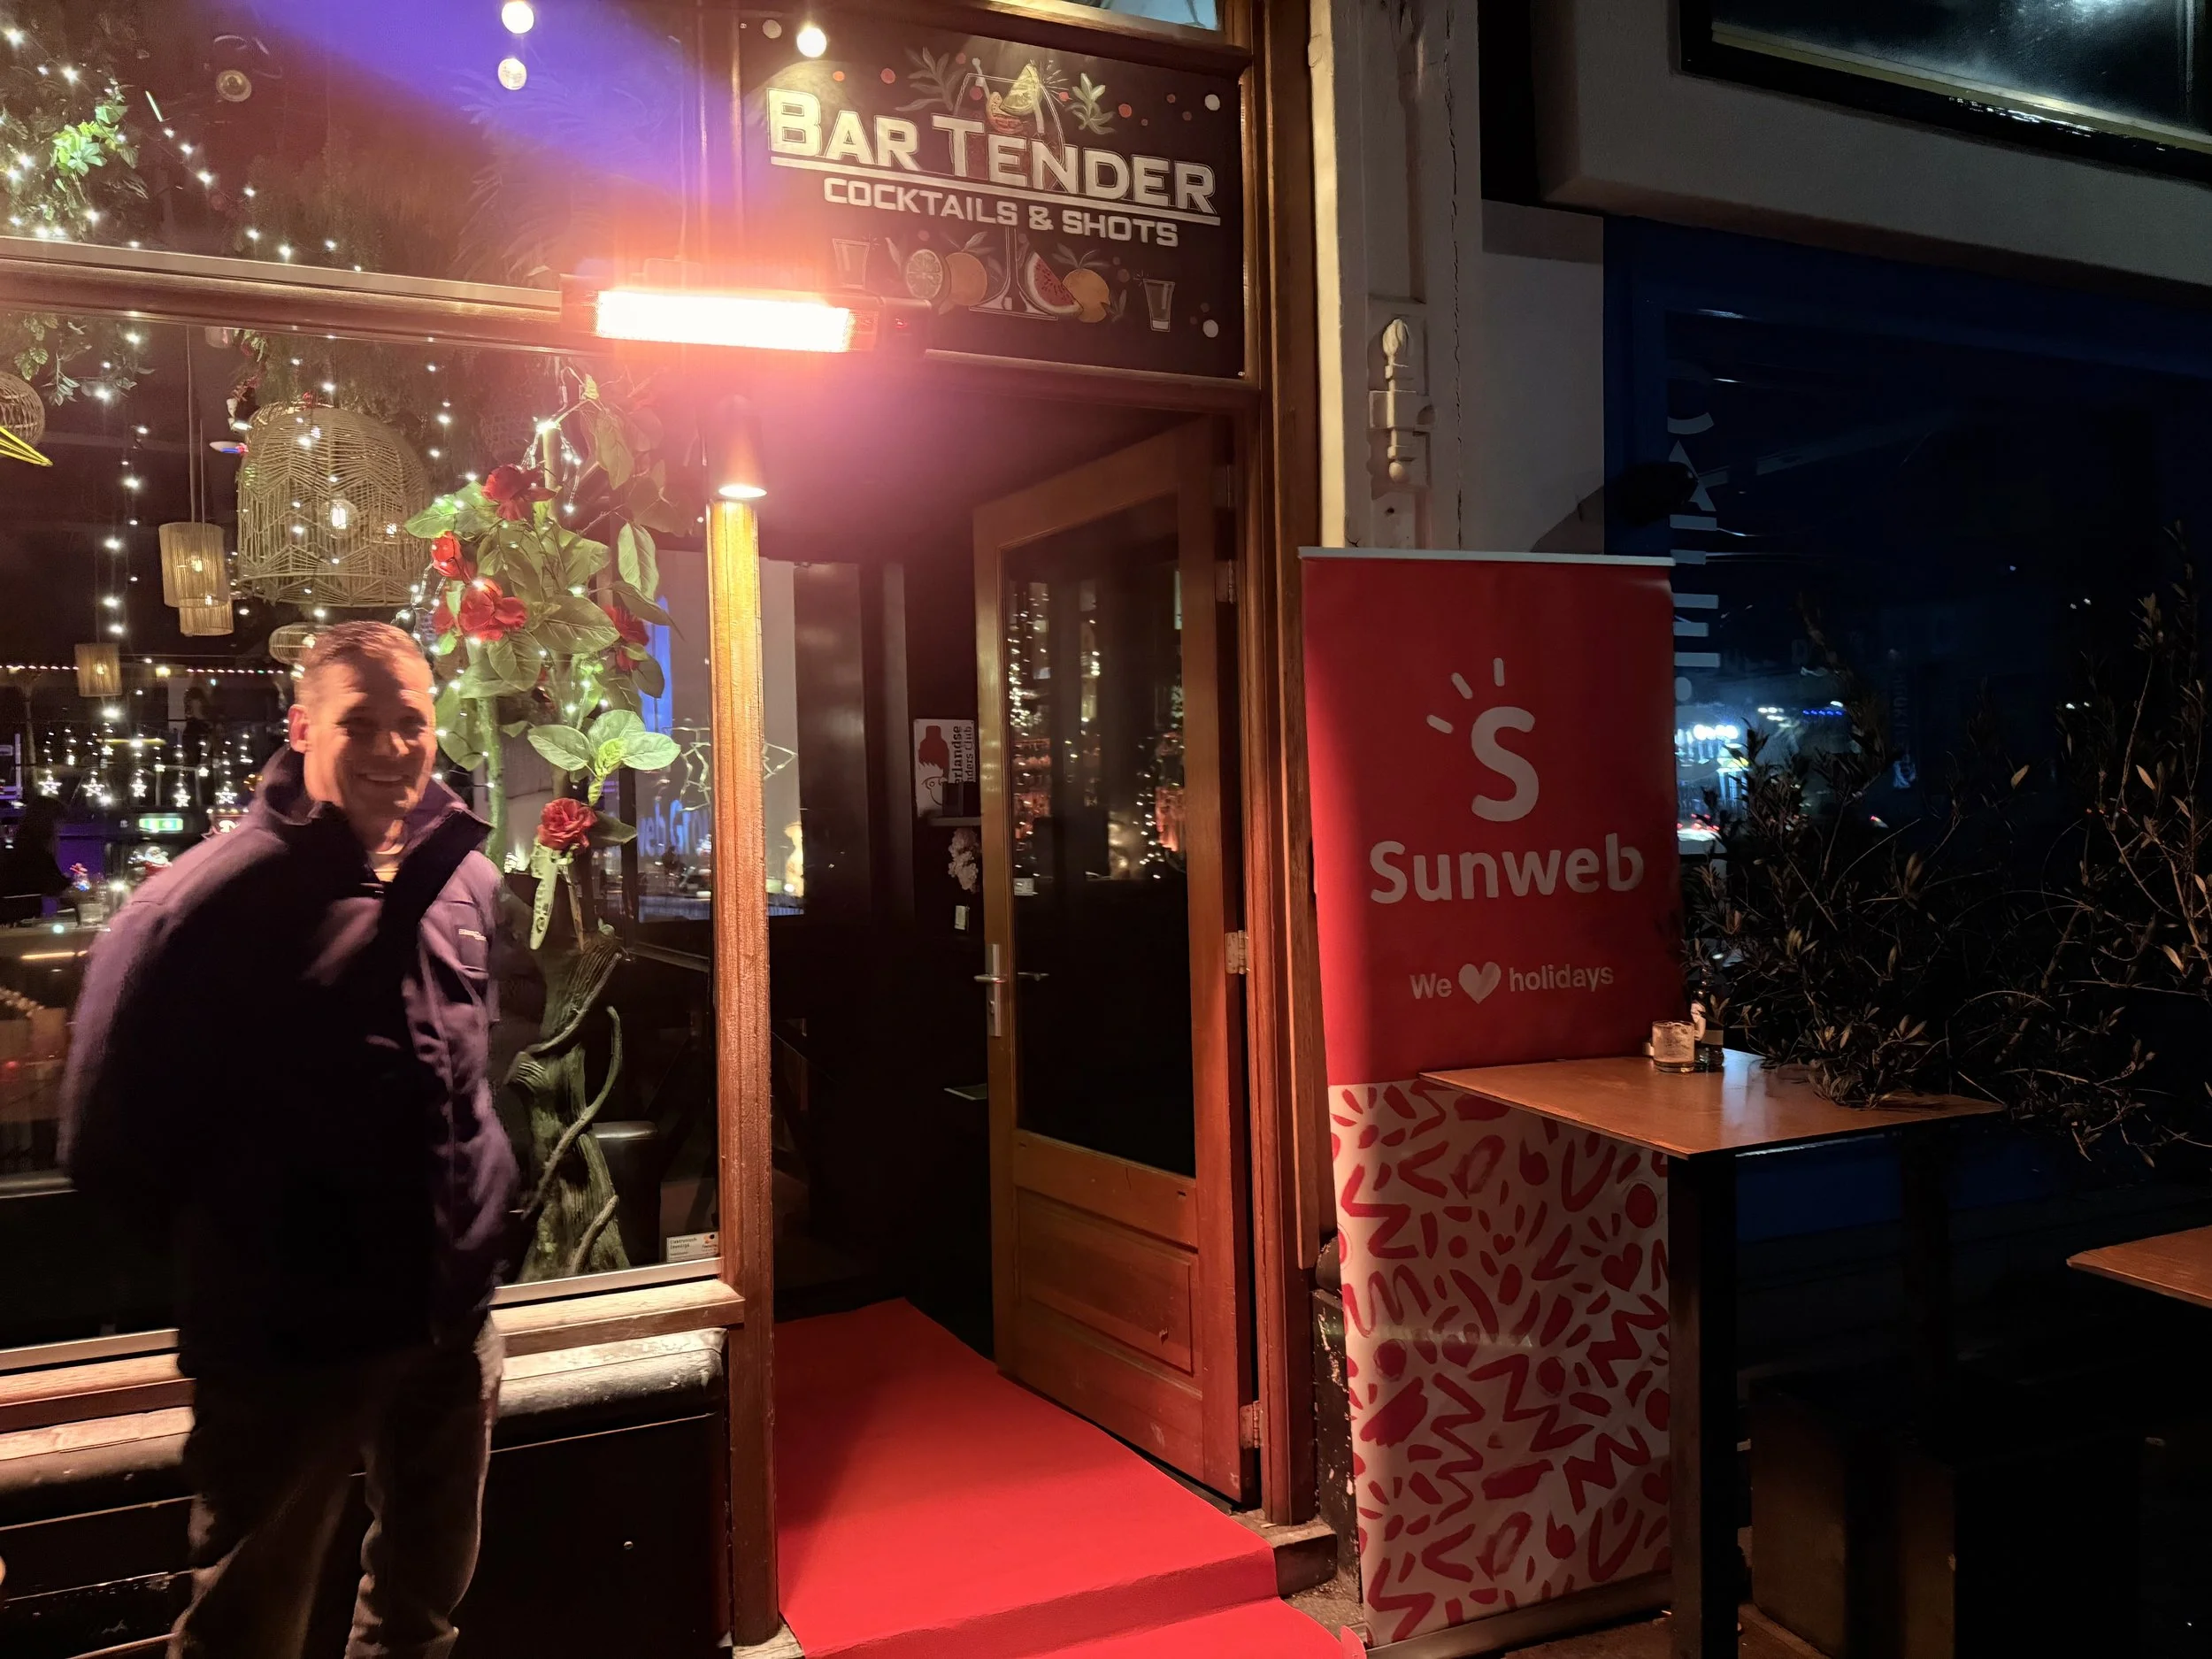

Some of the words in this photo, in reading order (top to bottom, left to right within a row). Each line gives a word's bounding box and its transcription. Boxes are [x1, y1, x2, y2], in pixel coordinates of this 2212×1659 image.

[824, 177, 1018, 227] COCKTAILS
[1028, 206, 1054, 231] &
[1062, 209, 1179, 248] SHOTS
[951, 726, 963, 784] erlandse
[964, 753, 974, 782] nders
[1369, 833, 1644, 904] Sunweb
[1409, 973, 1452, 999] We
[1509, 964, 1614, 998] holidays
